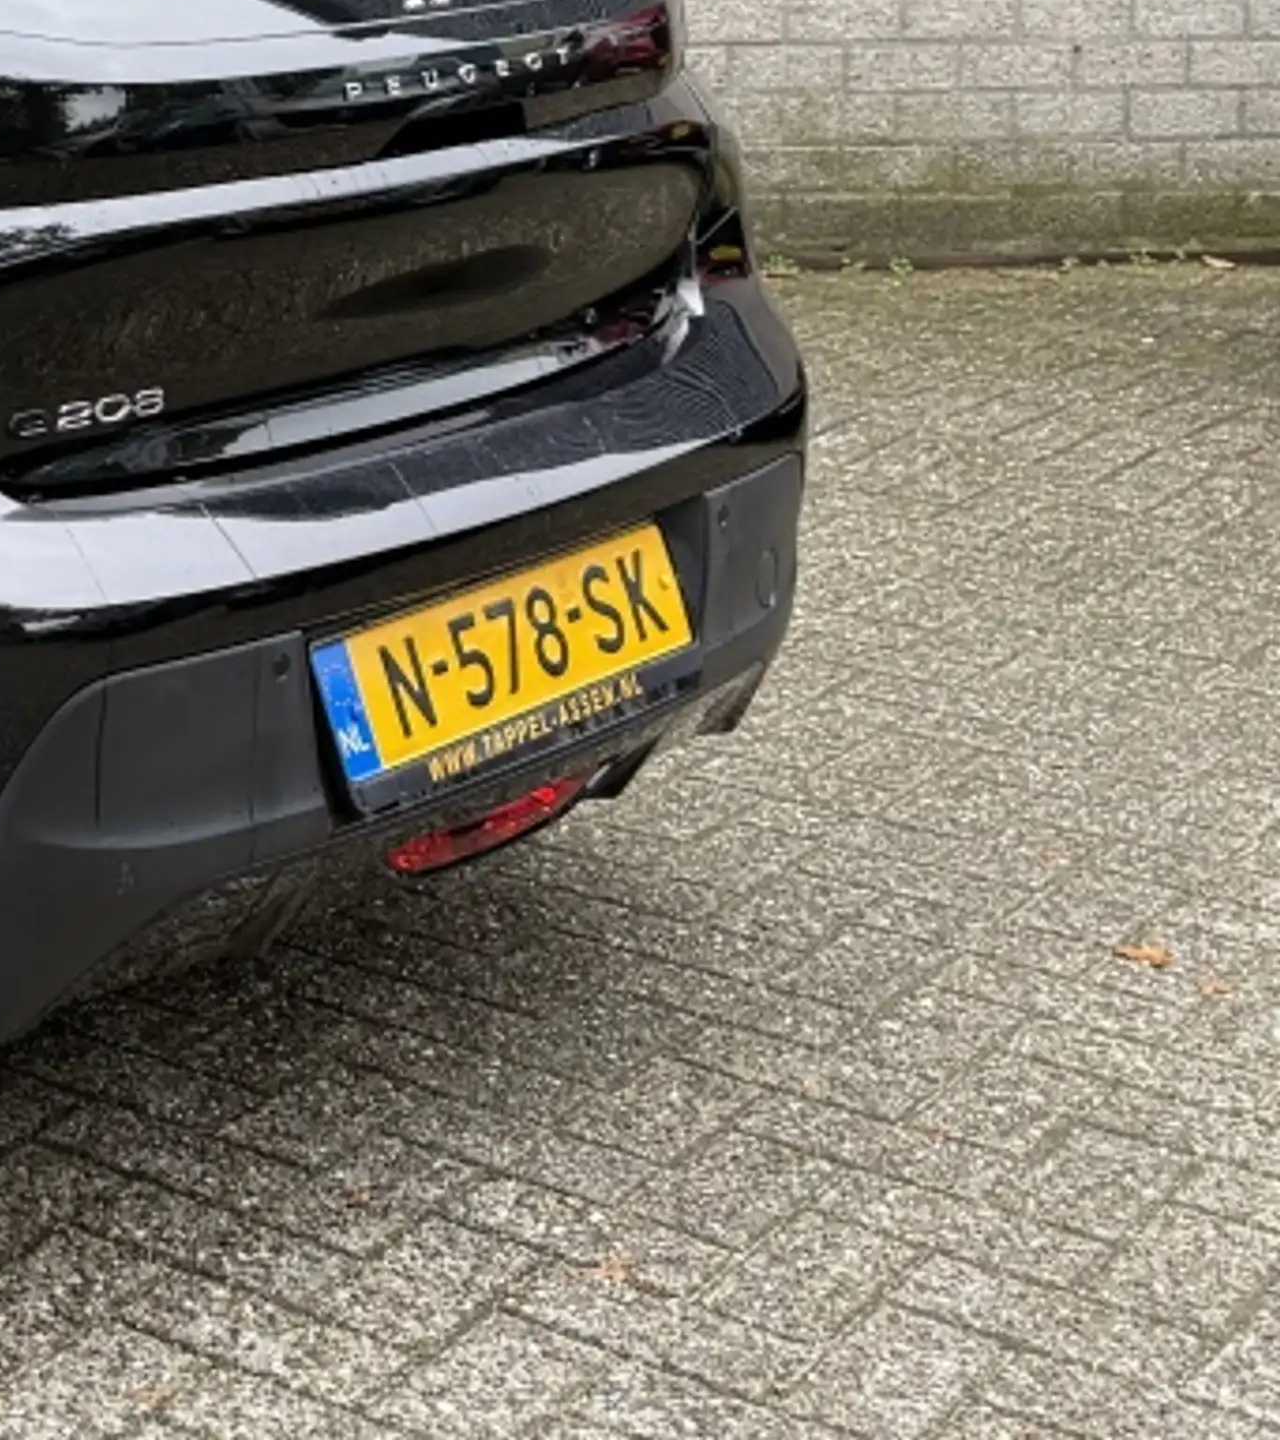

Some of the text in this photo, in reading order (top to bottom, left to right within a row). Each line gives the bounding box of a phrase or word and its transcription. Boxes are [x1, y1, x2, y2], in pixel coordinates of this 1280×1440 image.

[343, 46, 572, 102] PEUGEOT
[377, 547, 670, 738] N-578-SK
[337, 722, 371, 760] NL
